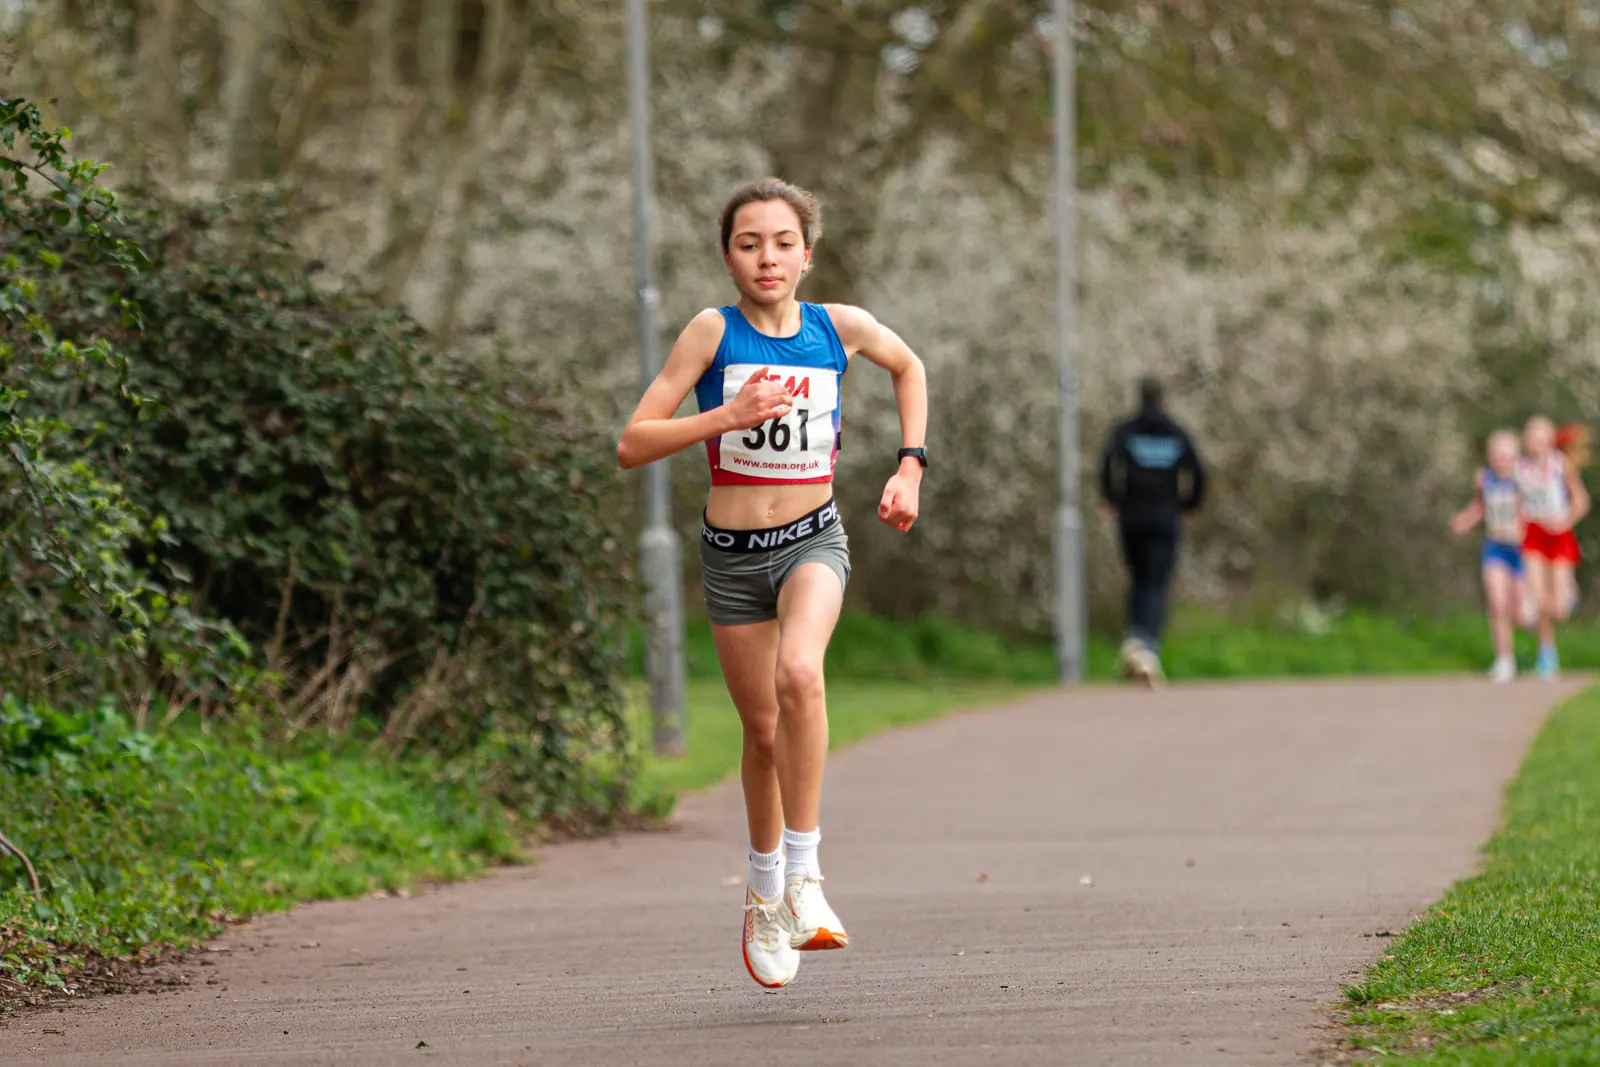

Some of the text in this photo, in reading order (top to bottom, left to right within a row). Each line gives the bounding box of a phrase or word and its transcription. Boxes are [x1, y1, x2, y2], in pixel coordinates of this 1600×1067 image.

[762, 374, 810, 399] AA
[742, 408, 809, 452] 361
[733, 455, 820, 472] www.seaa.org.uk
[747, 517, 814, 549] NIKE
